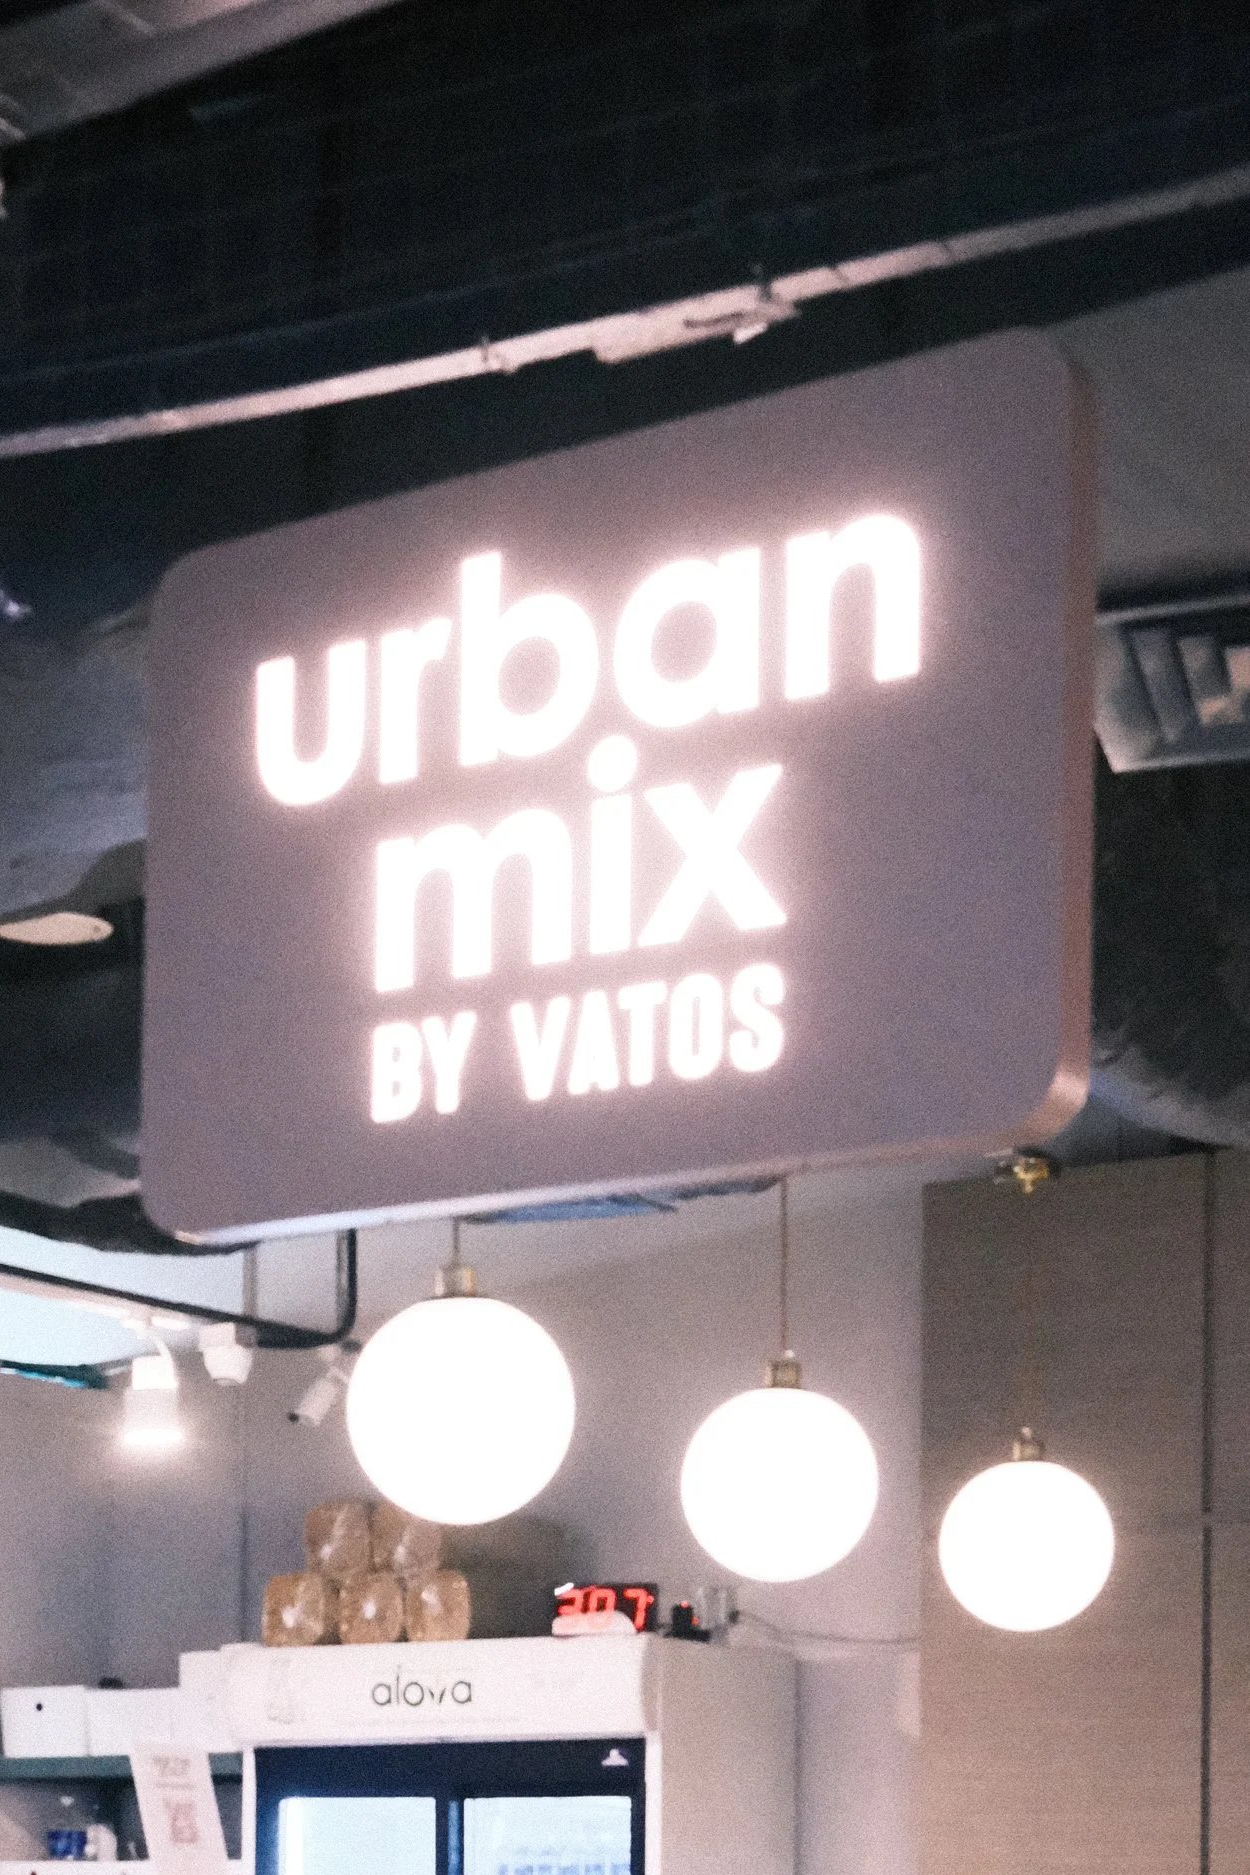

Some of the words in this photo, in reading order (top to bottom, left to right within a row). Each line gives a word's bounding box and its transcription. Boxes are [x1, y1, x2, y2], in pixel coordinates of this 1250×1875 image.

[254, 512, 922, 807] urban
[375, 734, 788, 993] mix
[371, 1012, 476, 1124] BY
[510, 963, 787, 1102] VATOS
